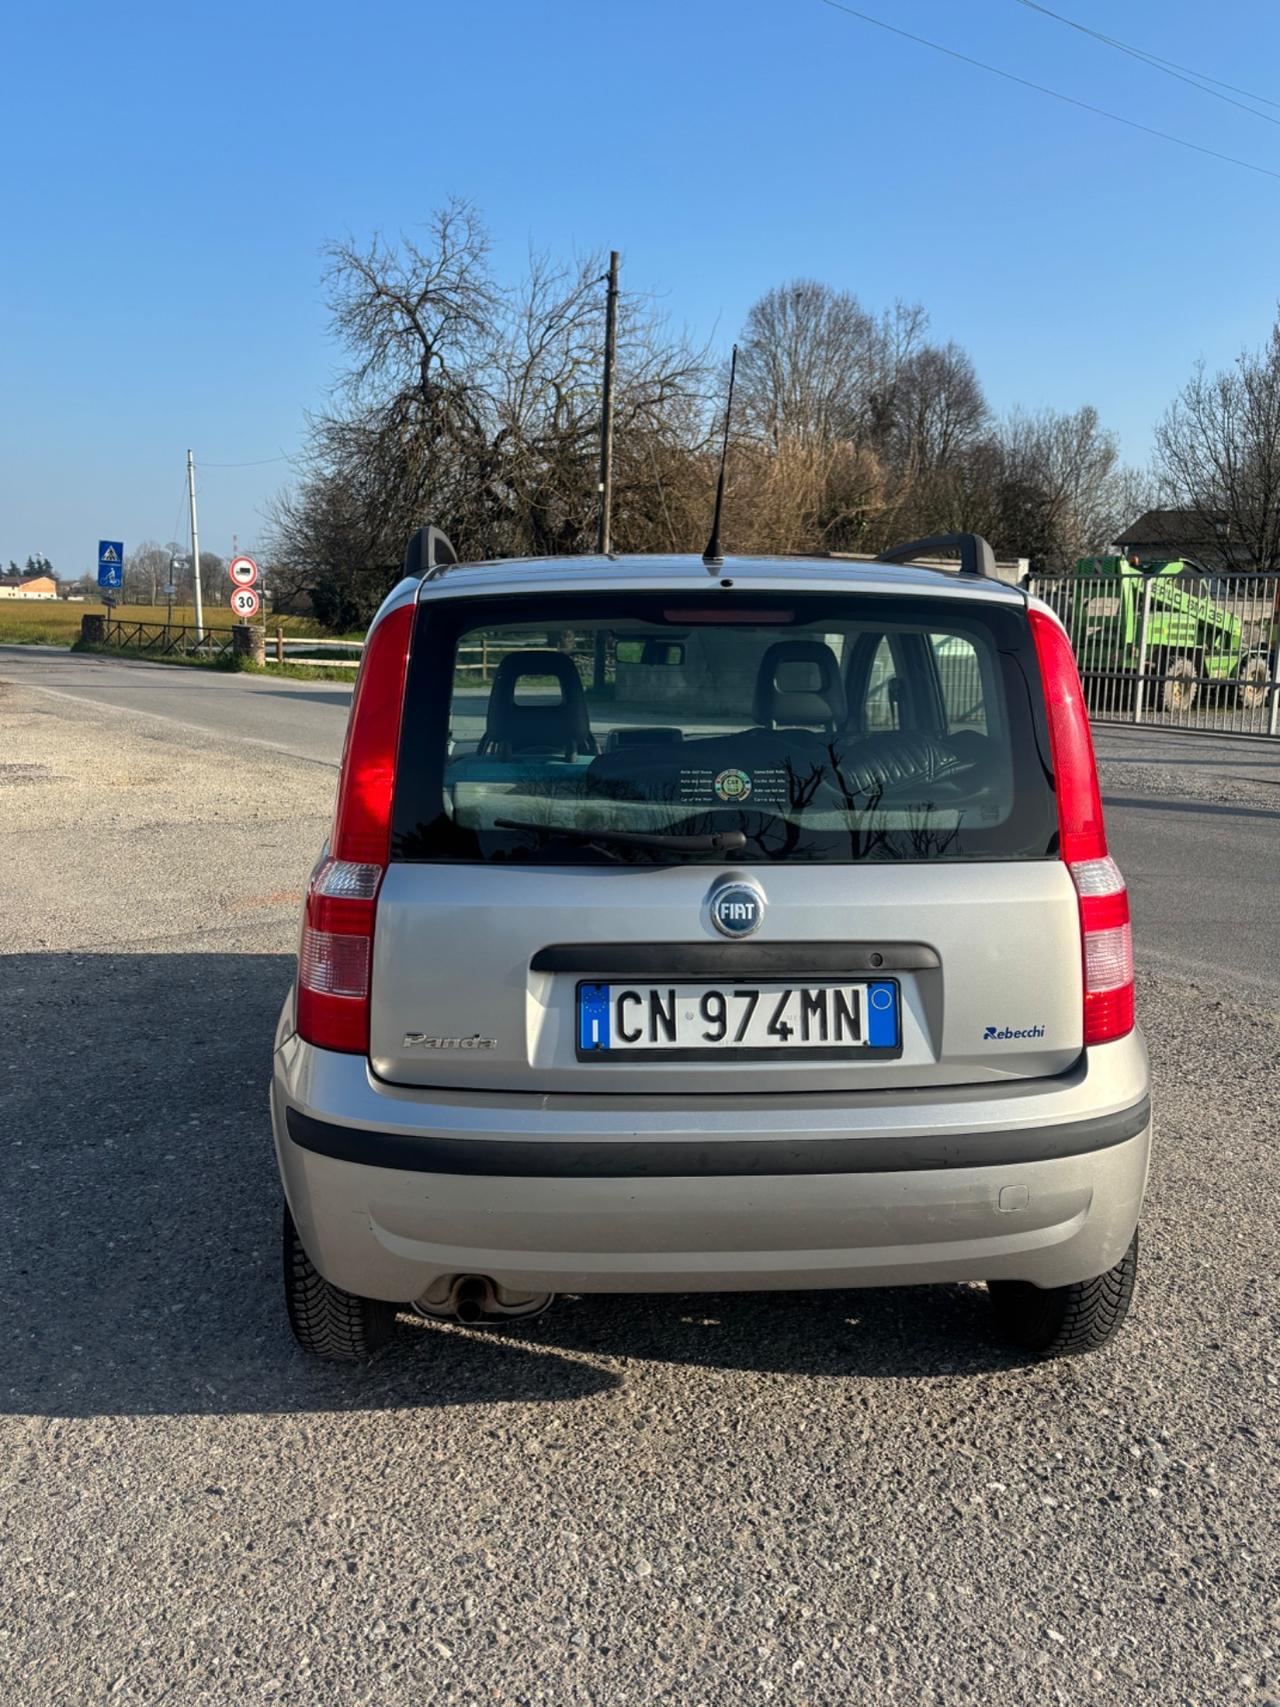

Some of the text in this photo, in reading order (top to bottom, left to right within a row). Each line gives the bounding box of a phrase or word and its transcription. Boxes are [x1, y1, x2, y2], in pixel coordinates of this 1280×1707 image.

[238, 596, 254, 608] 30
[1208, 609, 1223, 623] 35
[720, 903, 755, 919] FIAT
[617, 989, 677, 1042] CN
[700, 989, 861, 1042] 974MN
[983, 1025, 1046, 1040] Rebecchi
[403, 1032, 497, 1049] Panda
